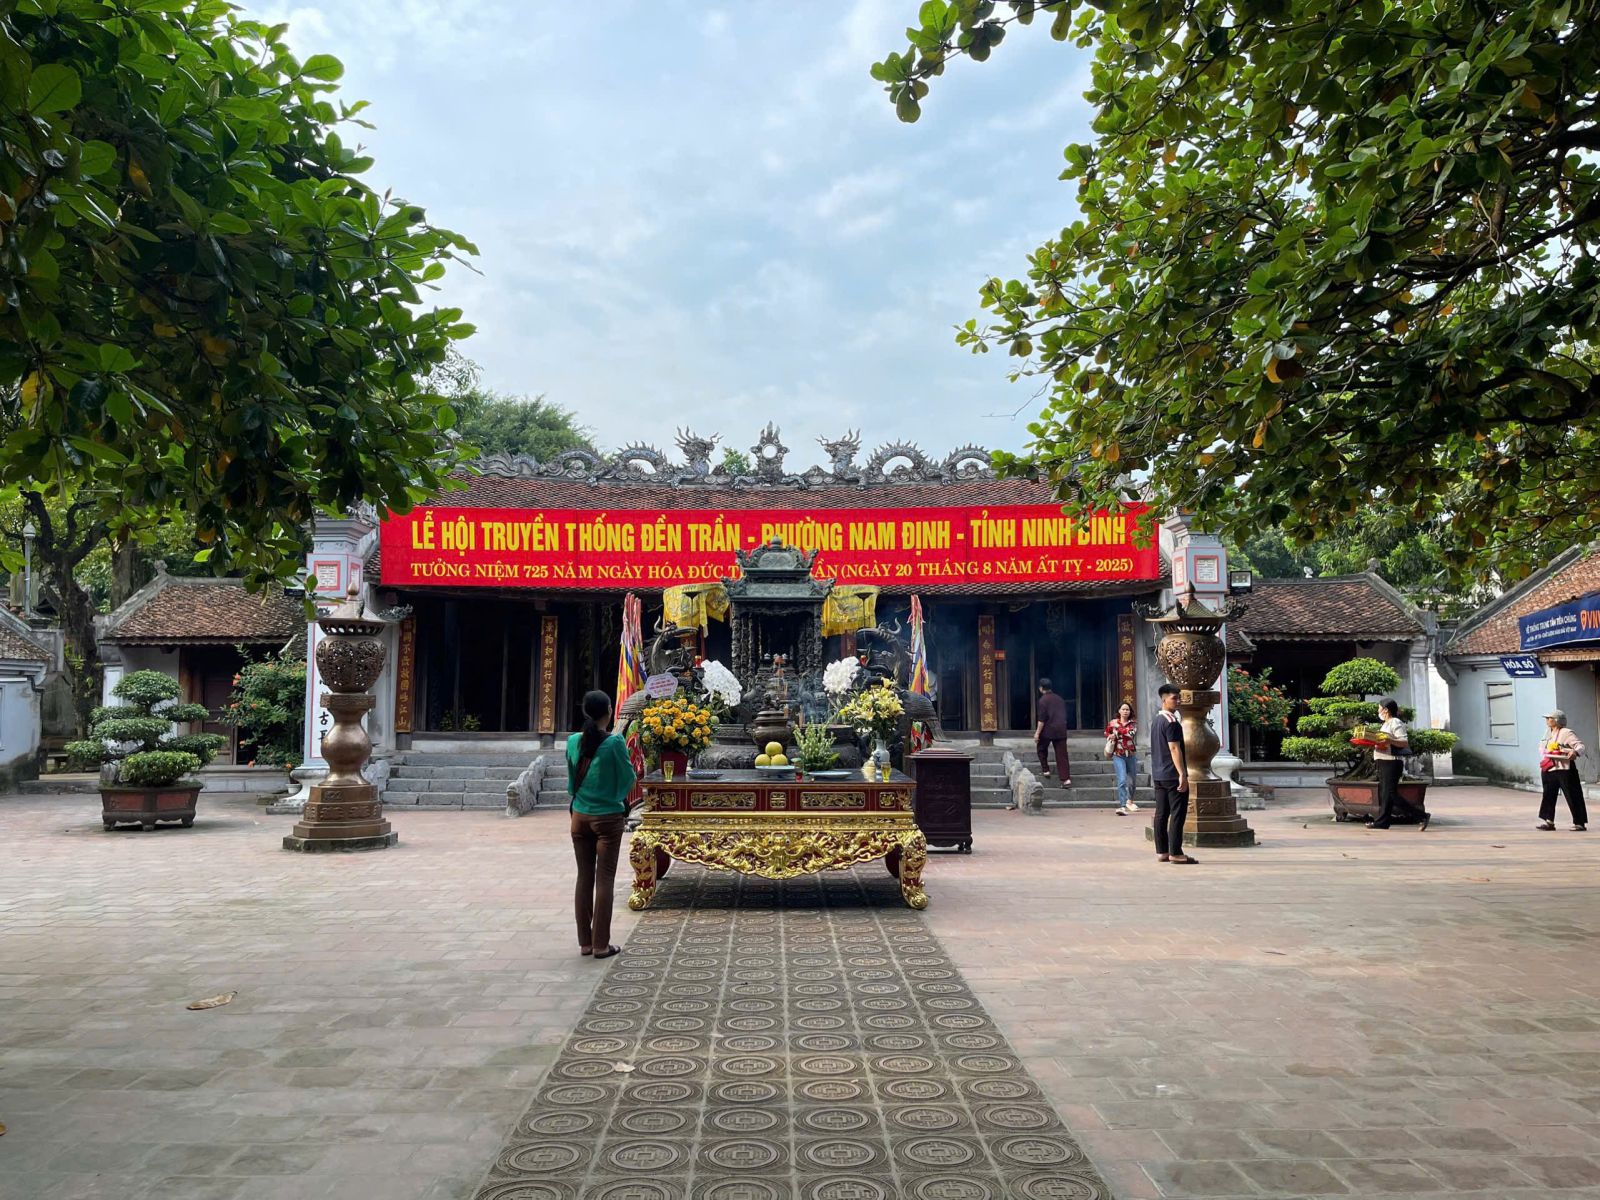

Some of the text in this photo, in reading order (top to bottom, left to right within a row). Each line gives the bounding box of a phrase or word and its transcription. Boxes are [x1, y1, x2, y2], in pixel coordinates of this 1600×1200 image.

[411, 510, 435, 550] LỄ
[441, 514, 476, 557] HỘI
[481, 513, 559, 551] TRUYỀN
[565, 513, 635, 552] THỐNG
[641, 514, 682, 552] ĐỀN
[690, 513, 741, 552] TRẦN
[761, 516, 843, 552] PHƯỜNG
[849, 521, 895, 551] NAM
[901, 520, 951, 556] ĐỊNH
[970, 510, 1016, 548] TỈNH
[1022, 518, 1072, 547] NINH
[411, 558, 470, 577] TƯỞNG
[475, 560, 518, 581] NIỆM
[524, 565, 548, 578] 725
[553, 562, 593, 579] NĂM
[597, 561, 644, 579] NGÀY
[648, 561, 684, 579] HÓA
[687, 561, 723, 579] ĐỨC
[895, 564, 912, 577] 20
[917, 557, 979, 577] THÁNG
[983, 562, 992, 575] 8
[995, 556, 1033, 575] NĂM
[1036, 555, 1059, 574] ẤT
[1095, 558, 1134, 575] 2025)
